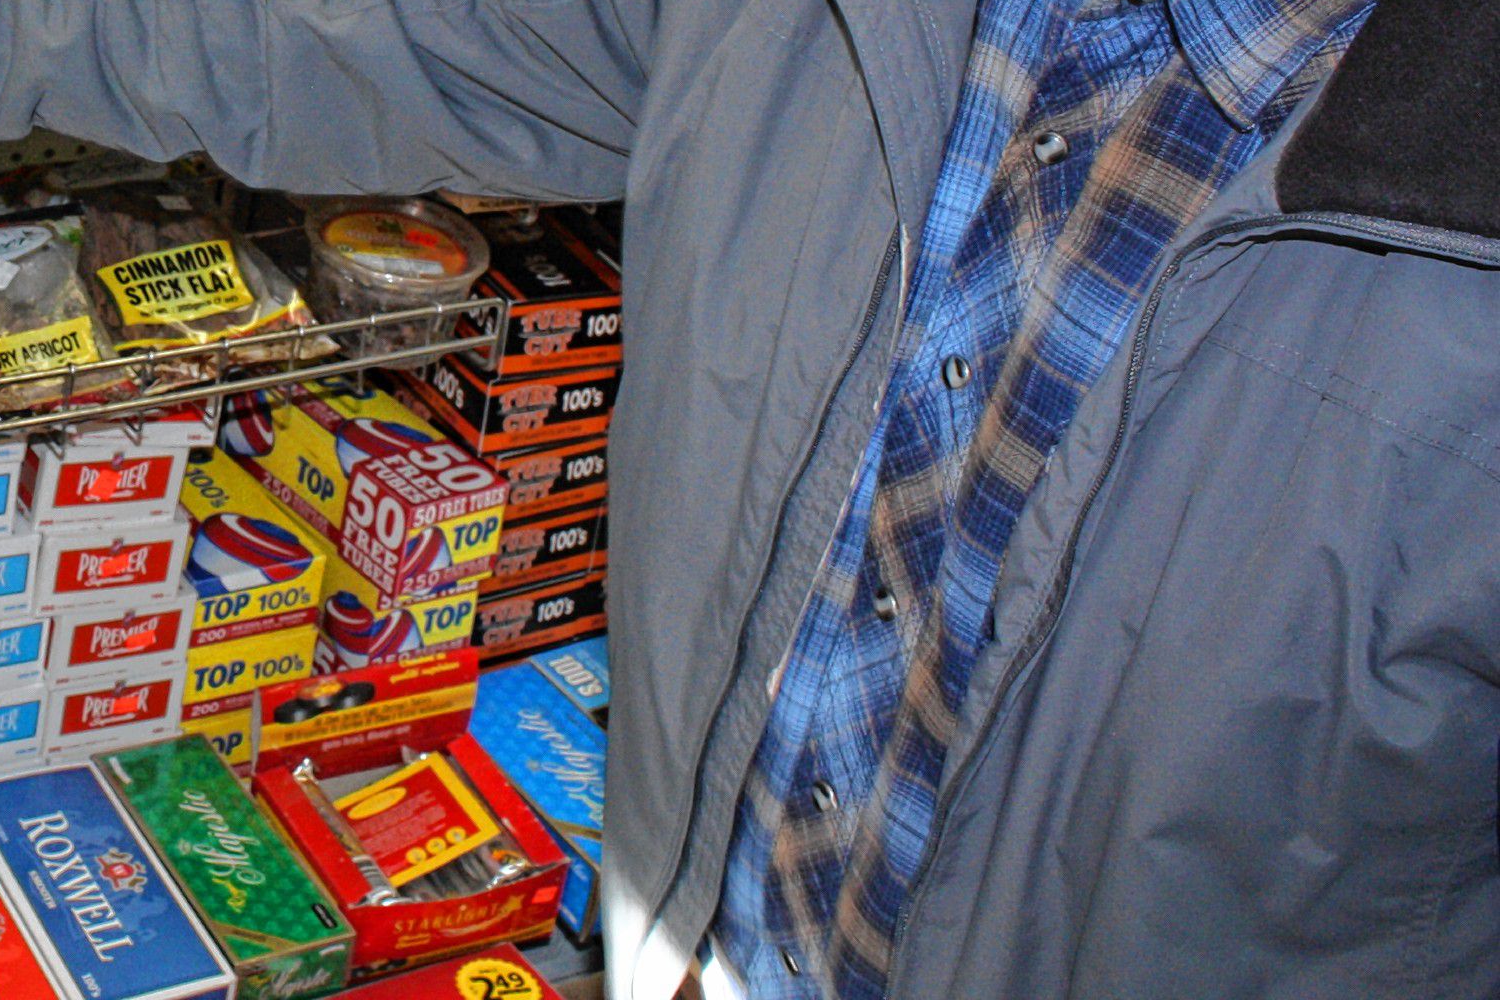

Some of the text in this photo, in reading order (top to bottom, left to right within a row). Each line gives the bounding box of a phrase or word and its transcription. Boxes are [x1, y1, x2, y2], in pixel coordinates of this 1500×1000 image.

[113, 243, 228, 285] CINNAMON
[124, 276, 184, 307] STICK
[188, 269, 237, 295] FLAT
[22, 331, 82, 362] APRICOT
[524, 333, 575, 356] CUT
[500, 384, 603, 412] TUBE 100's
[502, 409, 551, 432] CUT
[297, 455, 336, 501] TOP
[365, 458, 429, 504] TUBES
[380, 453, 450, 500] FREE
[408, 443, 494, 493] 50
[508, 455, 605, 481] TUBE 100's
[261, 472, 292, 505] 250
[349, 472, 406, 550] 50
[412, 485, 506, 528] 50 FREE TUBES
[341, 516, 400, 574] FREE
[452, 515, 499, 550] TOP
[550, 527, 588, 553] 100's
[341, 537, 398, 595] TUBES
[404, 570, 440, 595] 250
[200, 586, 311, 622] TOP 100's
[424, 600, 472, 633] TOP
[537, 596, 575, 623] 100's
[196, 627, 227, 644] 200
[194, 655, 305, 692] TOP 100's
[191, 700, 220, 717] 200
[211, 731, 244, 756] OP
[179, 789, 267, 886] Majestic
[19, 809, 134, 963] ROXWELL
